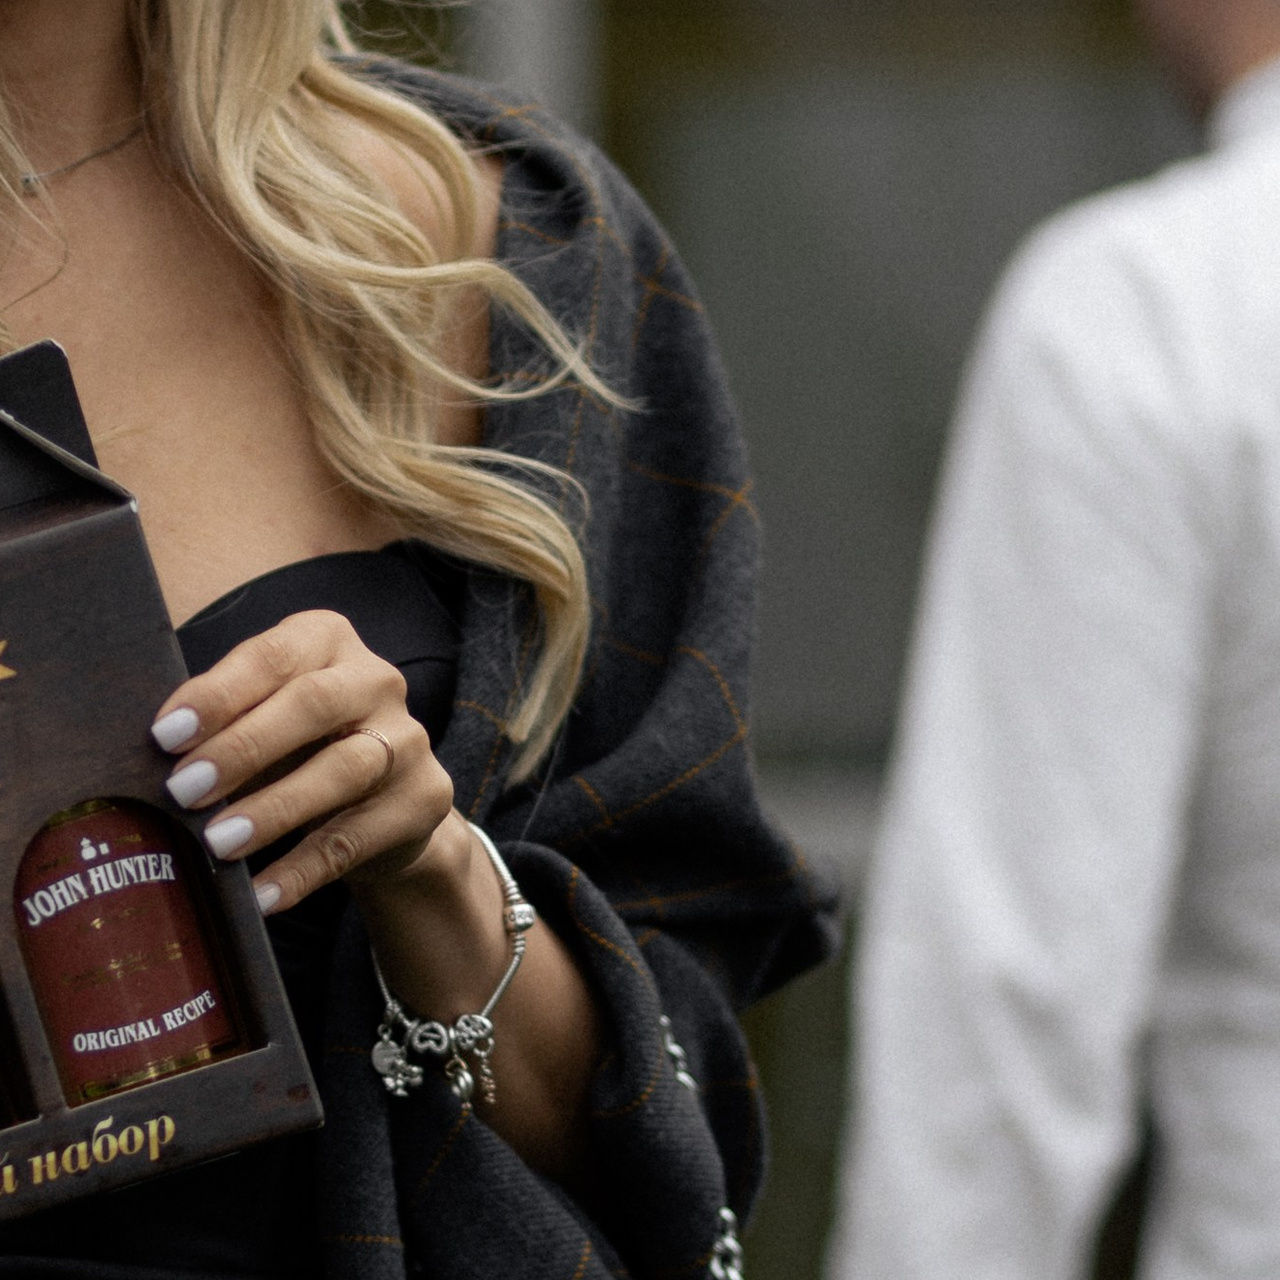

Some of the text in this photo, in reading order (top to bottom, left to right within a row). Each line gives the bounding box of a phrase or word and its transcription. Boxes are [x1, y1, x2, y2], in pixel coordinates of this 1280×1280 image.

[22, 872, 90, 928] JOHN
[86, 852, 176, 896] HUNTER
[72, 989, 217, 1053] ORIGINAL RECIPE
[27, 1114, 177, 1186] набор
